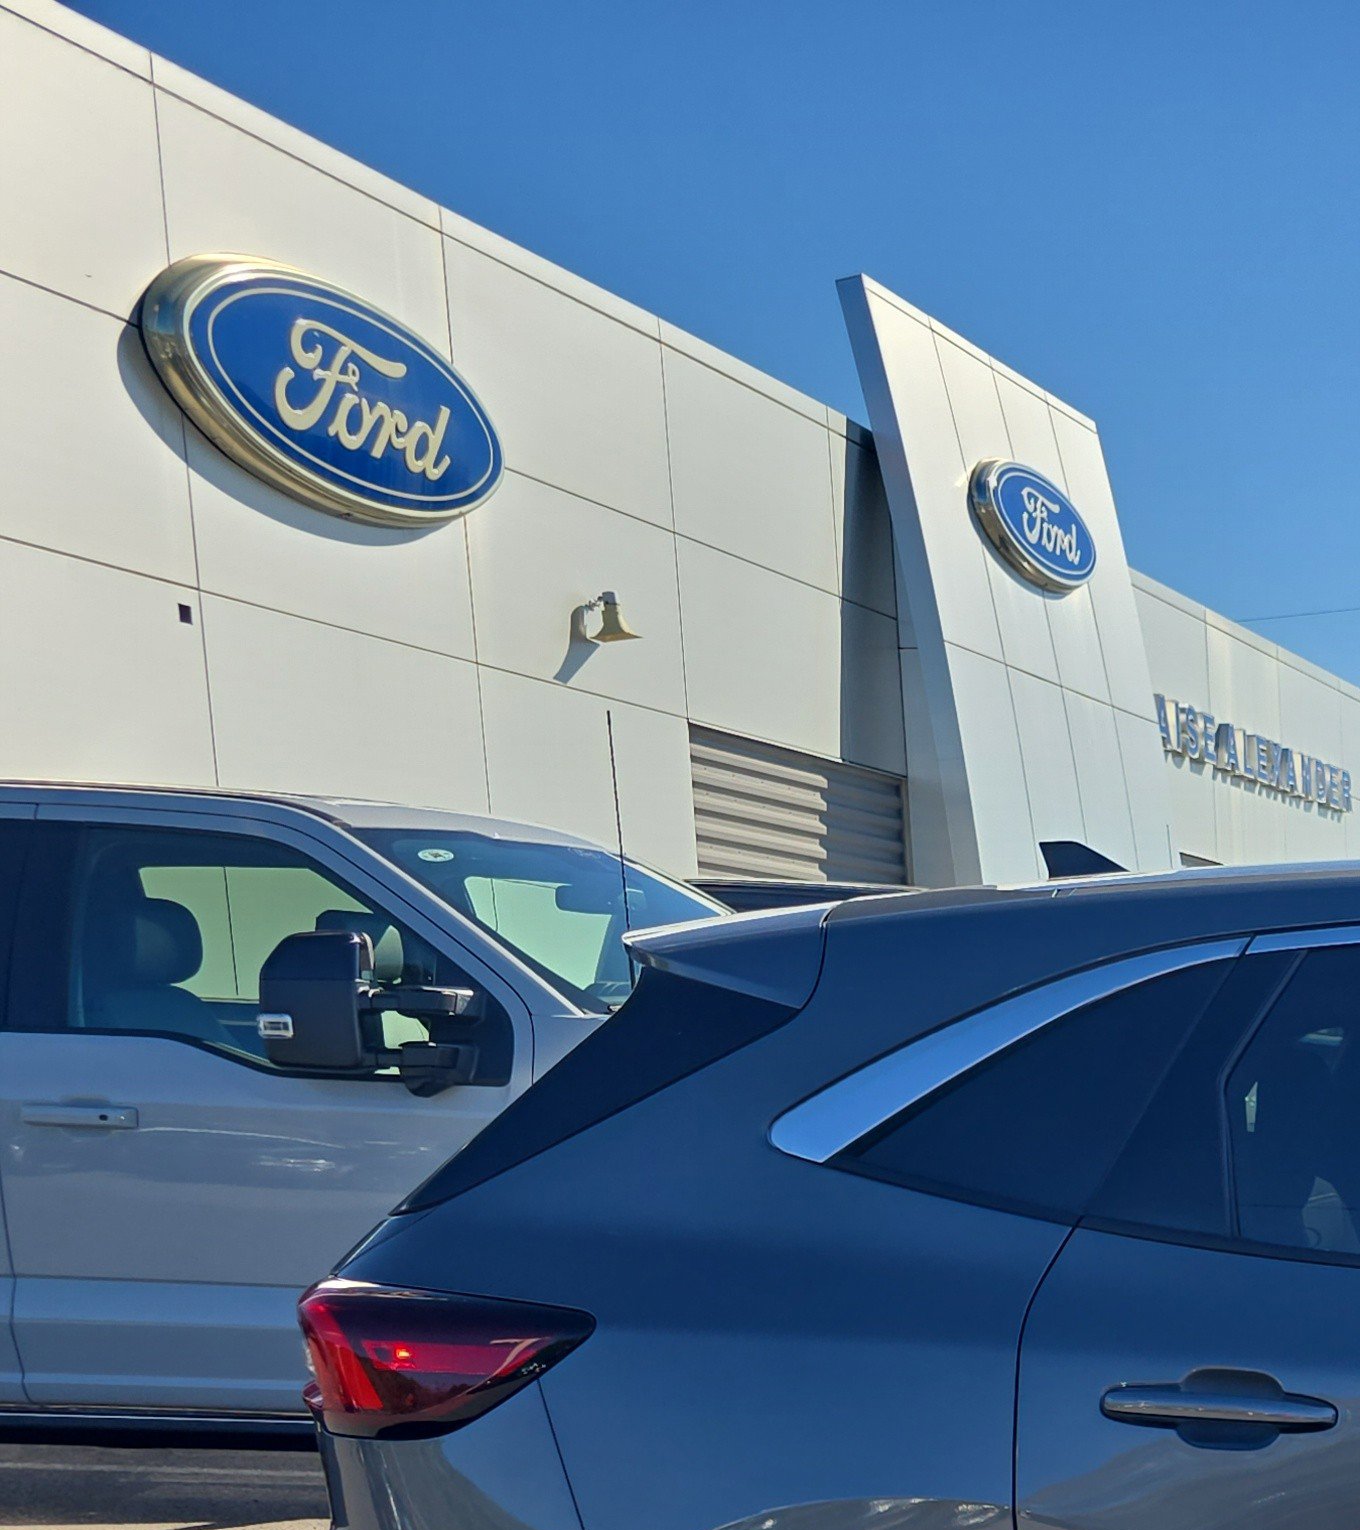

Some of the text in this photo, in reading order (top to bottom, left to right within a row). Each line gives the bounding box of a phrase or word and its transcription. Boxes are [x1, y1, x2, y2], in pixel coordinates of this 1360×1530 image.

[274, 318, 450, 480] Ford
[1021, 487, 1081, 566] Ford
[1216, 723, 1353, 812] ALEXANDER
